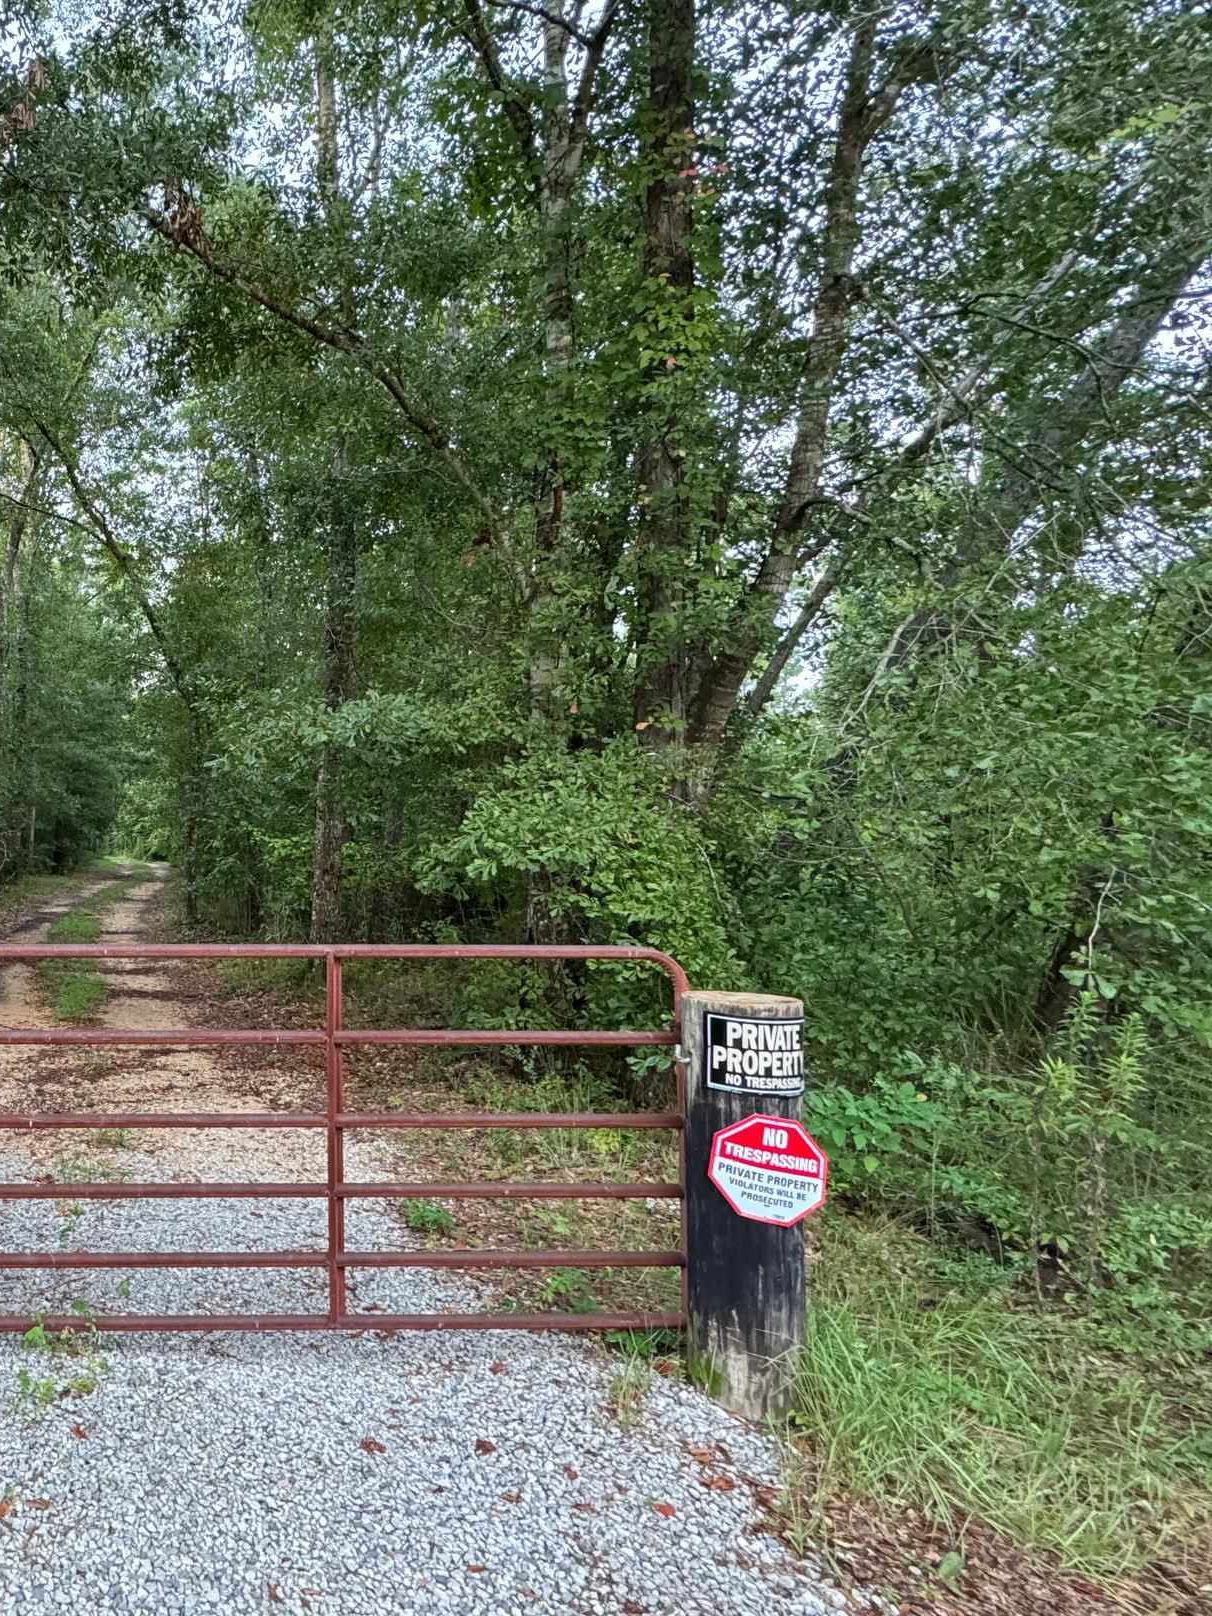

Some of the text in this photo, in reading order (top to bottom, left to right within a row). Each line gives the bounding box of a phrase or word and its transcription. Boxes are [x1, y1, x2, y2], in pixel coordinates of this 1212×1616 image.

[726, 1022, 801, 1051] PRIVATE
[725, 1073, 742, 1086] NO
[762, 1127, 789, 1149] NO
[724, 1141, 818, 1173] TRESPASSING
[718, 1162, 819, 1193] PRIVATE PROPERTY
[729, 1177, 808, 1201] VIOLATORS WILL BE
[741, 1191, 793, 1208] PROSECUTED
